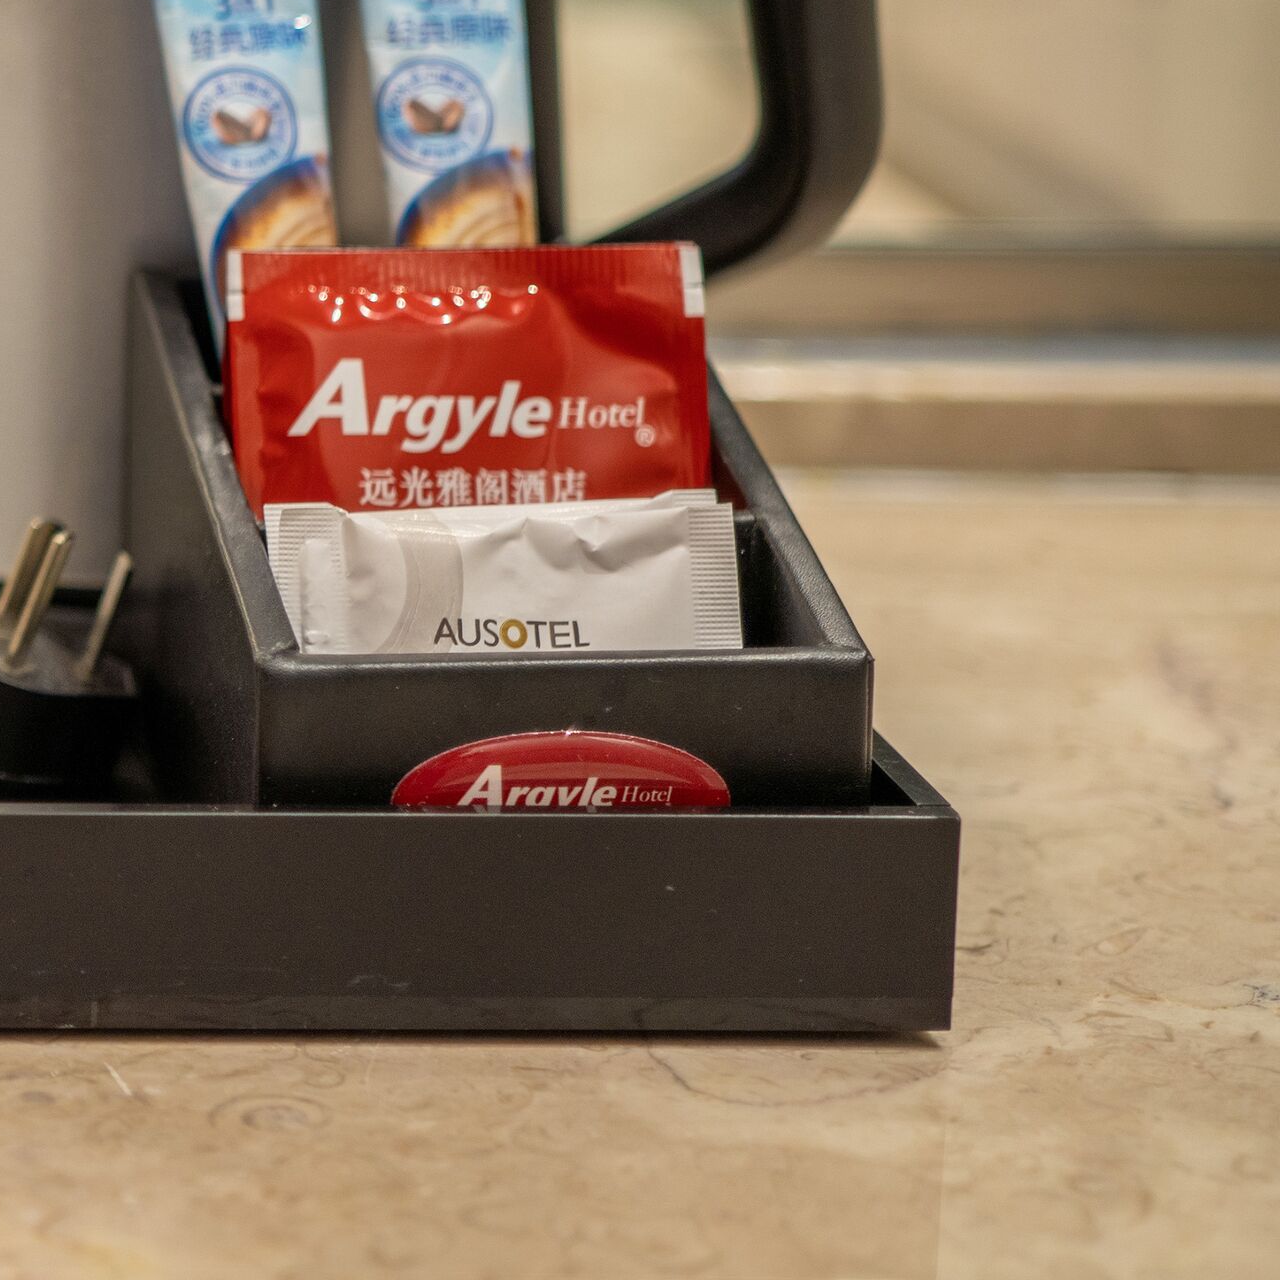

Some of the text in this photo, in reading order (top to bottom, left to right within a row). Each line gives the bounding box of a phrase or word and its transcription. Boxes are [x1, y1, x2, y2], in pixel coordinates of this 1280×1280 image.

[287, 357, 647, 454] Argyle Hotel
[358, 466, 587, 509] 远光雅阁酒店
[433, 617, 590, 649] AUSOTEL
[621, 785, 672, 804] Hotel
